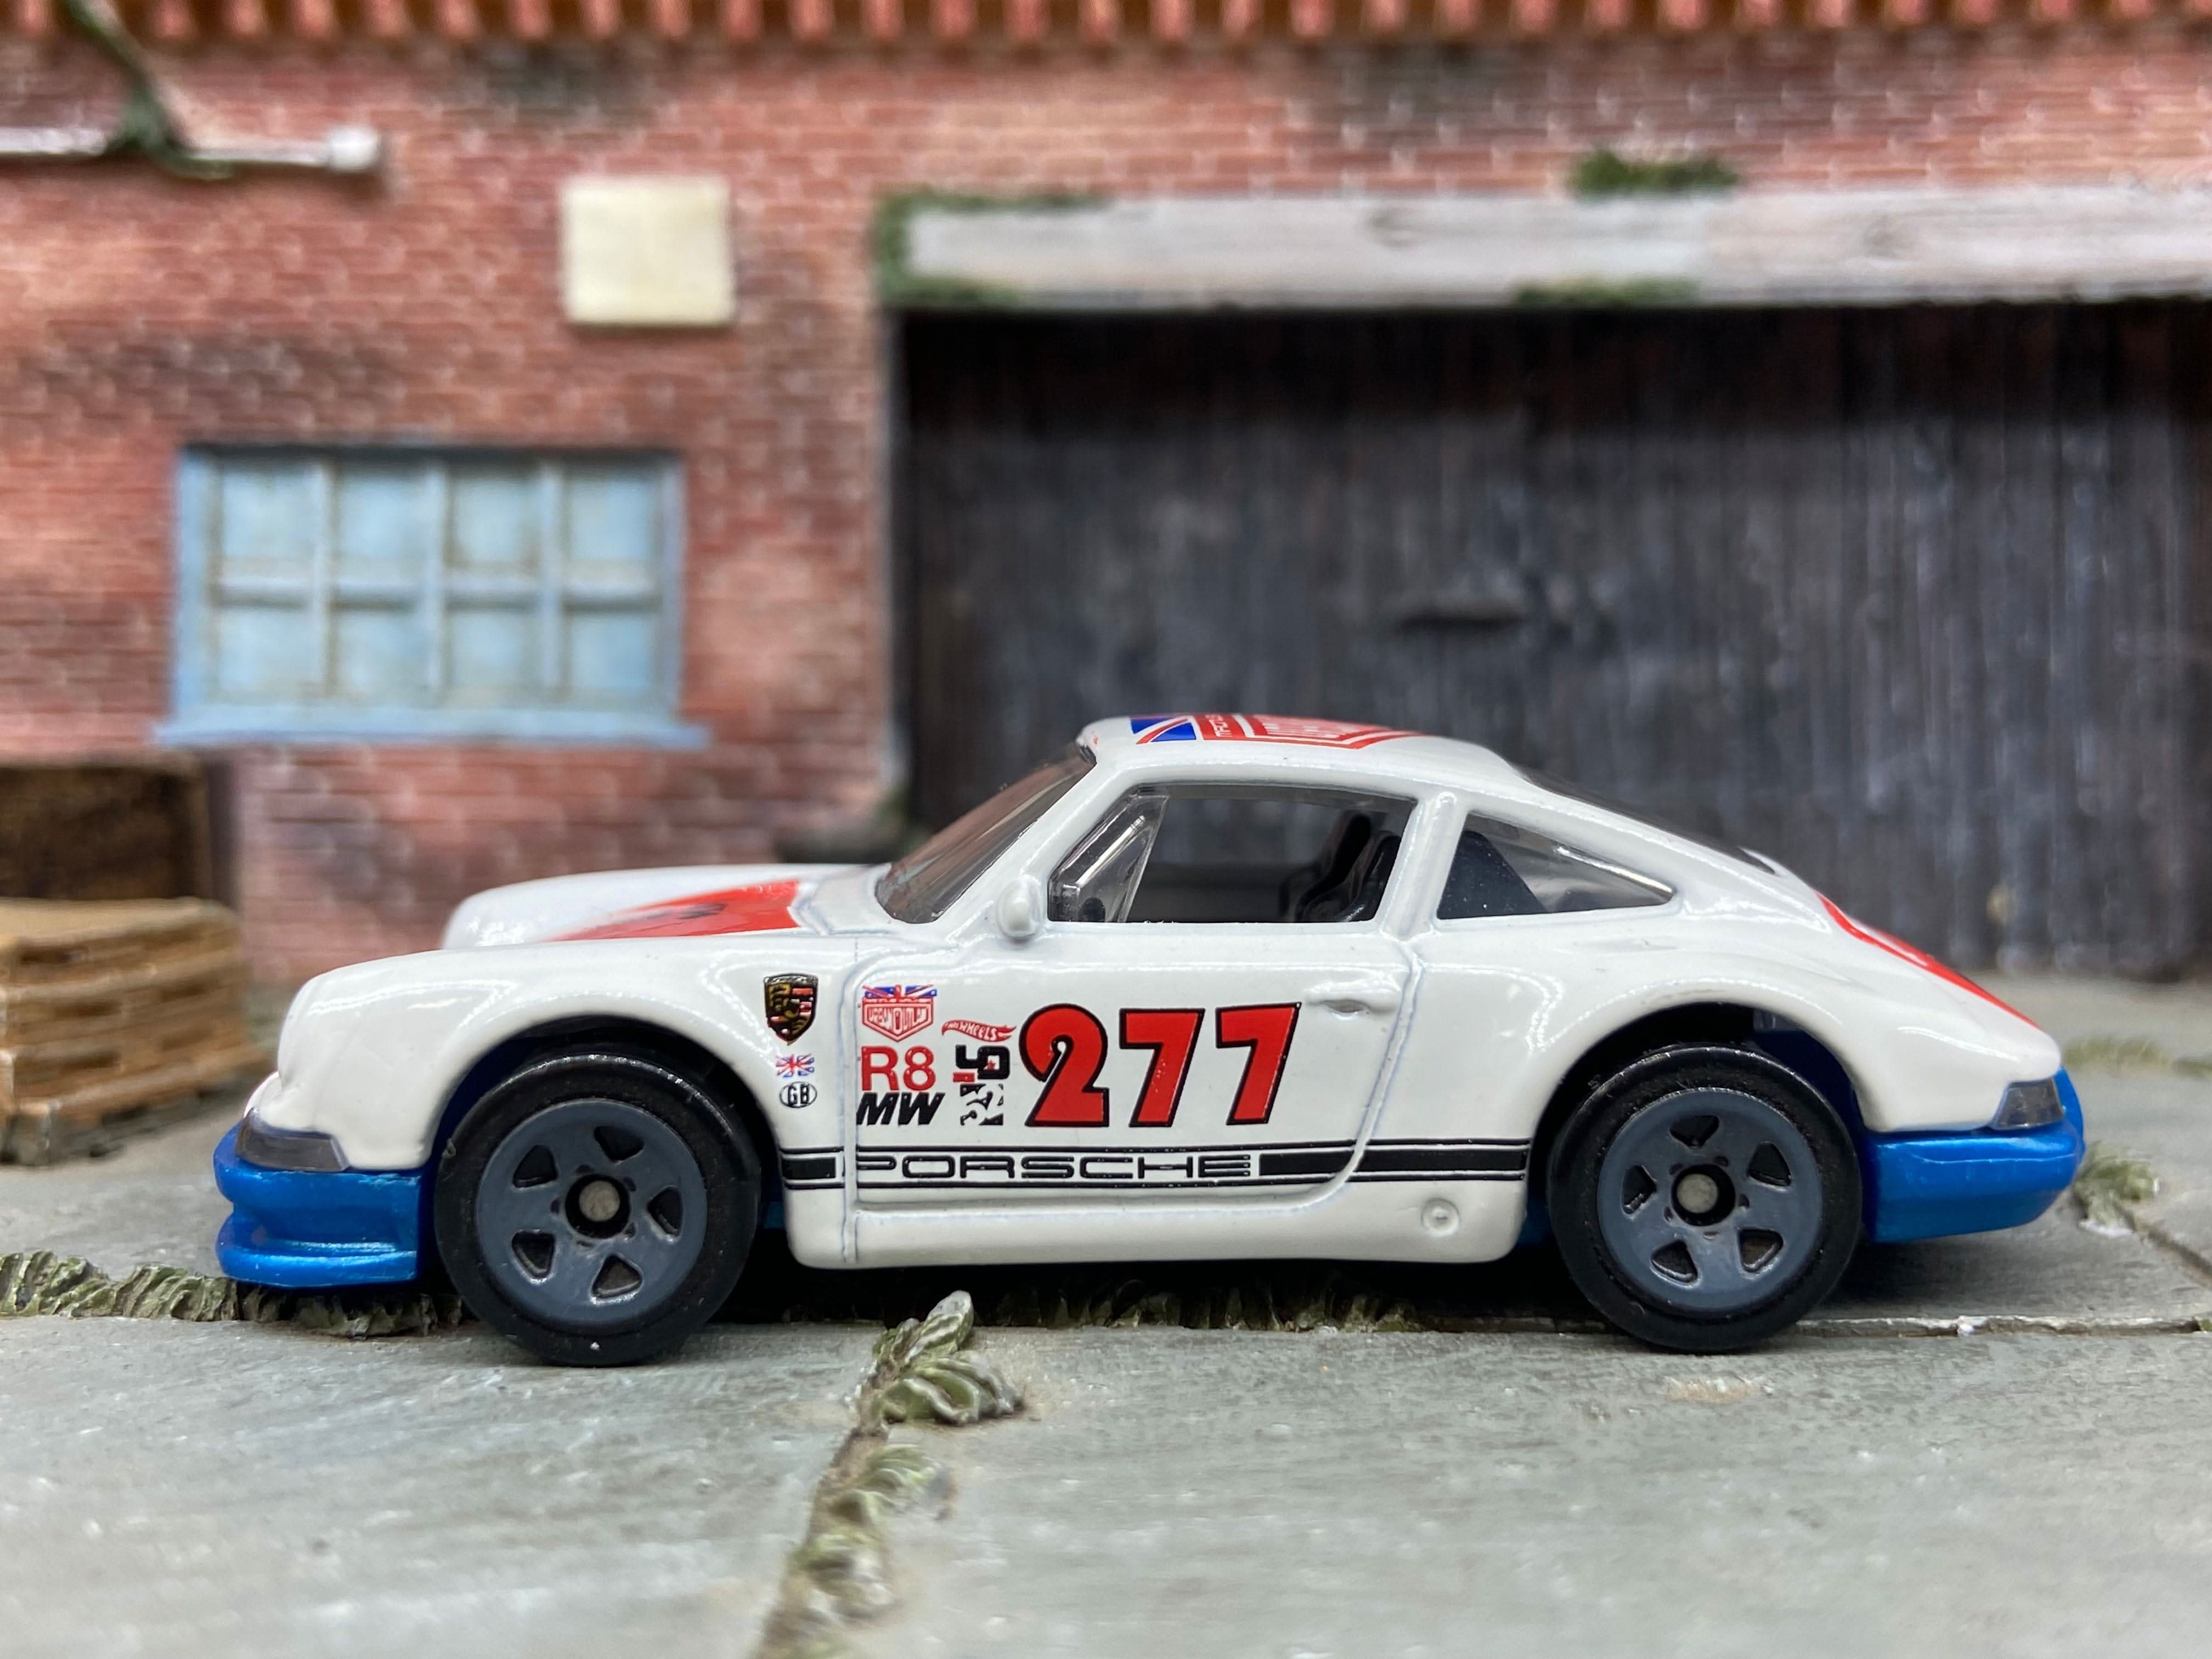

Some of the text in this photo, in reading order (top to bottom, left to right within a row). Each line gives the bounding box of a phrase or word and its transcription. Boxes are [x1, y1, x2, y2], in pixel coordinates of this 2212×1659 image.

[861, 1046, 937, 1091] R8
[1019, 1002, 1301, 1127] 277
[788, 1084, 809, 1106] GB
[856, 1092, 946, 1126] MW
[842, 1154, 1251, 1179] PORSCHE
